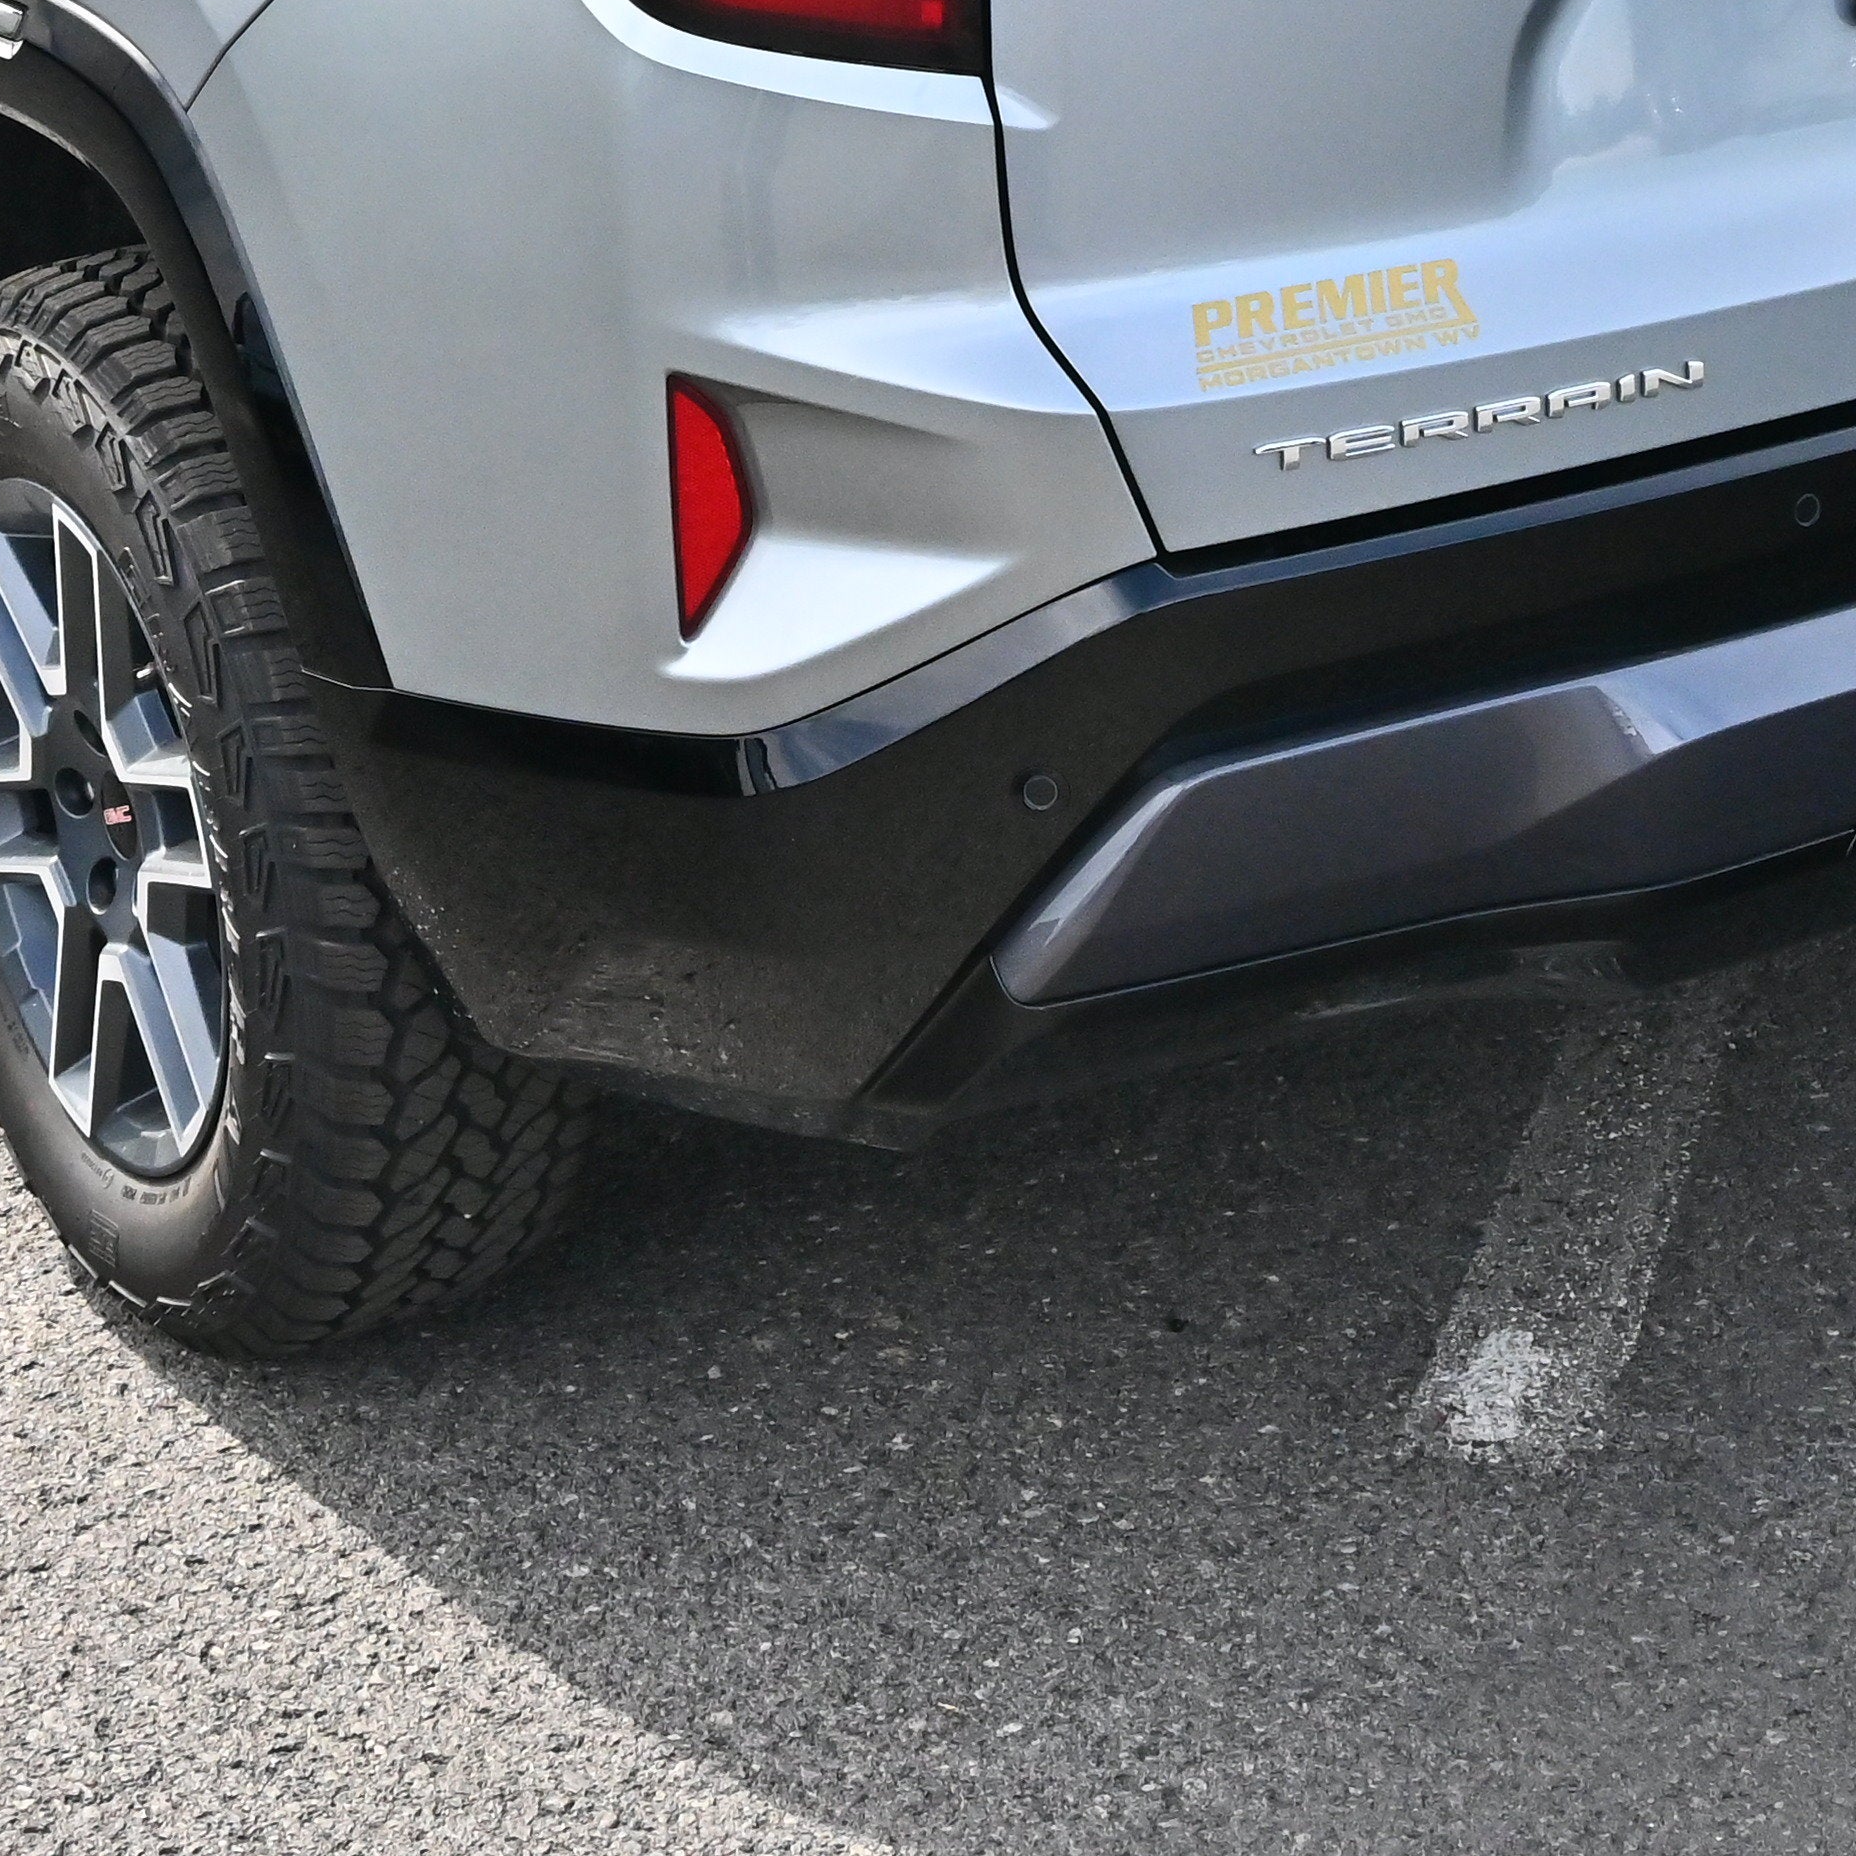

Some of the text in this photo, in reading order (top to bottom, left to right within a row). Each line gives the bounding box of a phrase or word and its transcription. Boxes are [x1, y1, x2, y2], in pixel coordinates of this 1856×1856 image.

[1191, 258, 1478, 347] PREMIER
[1196, 304, 1445, 364] CHEVROLET GMC
[1198, 324, 1481, 393] MORGANTOWN WV
[1254, 360, 1704, 470] TERRAIN
